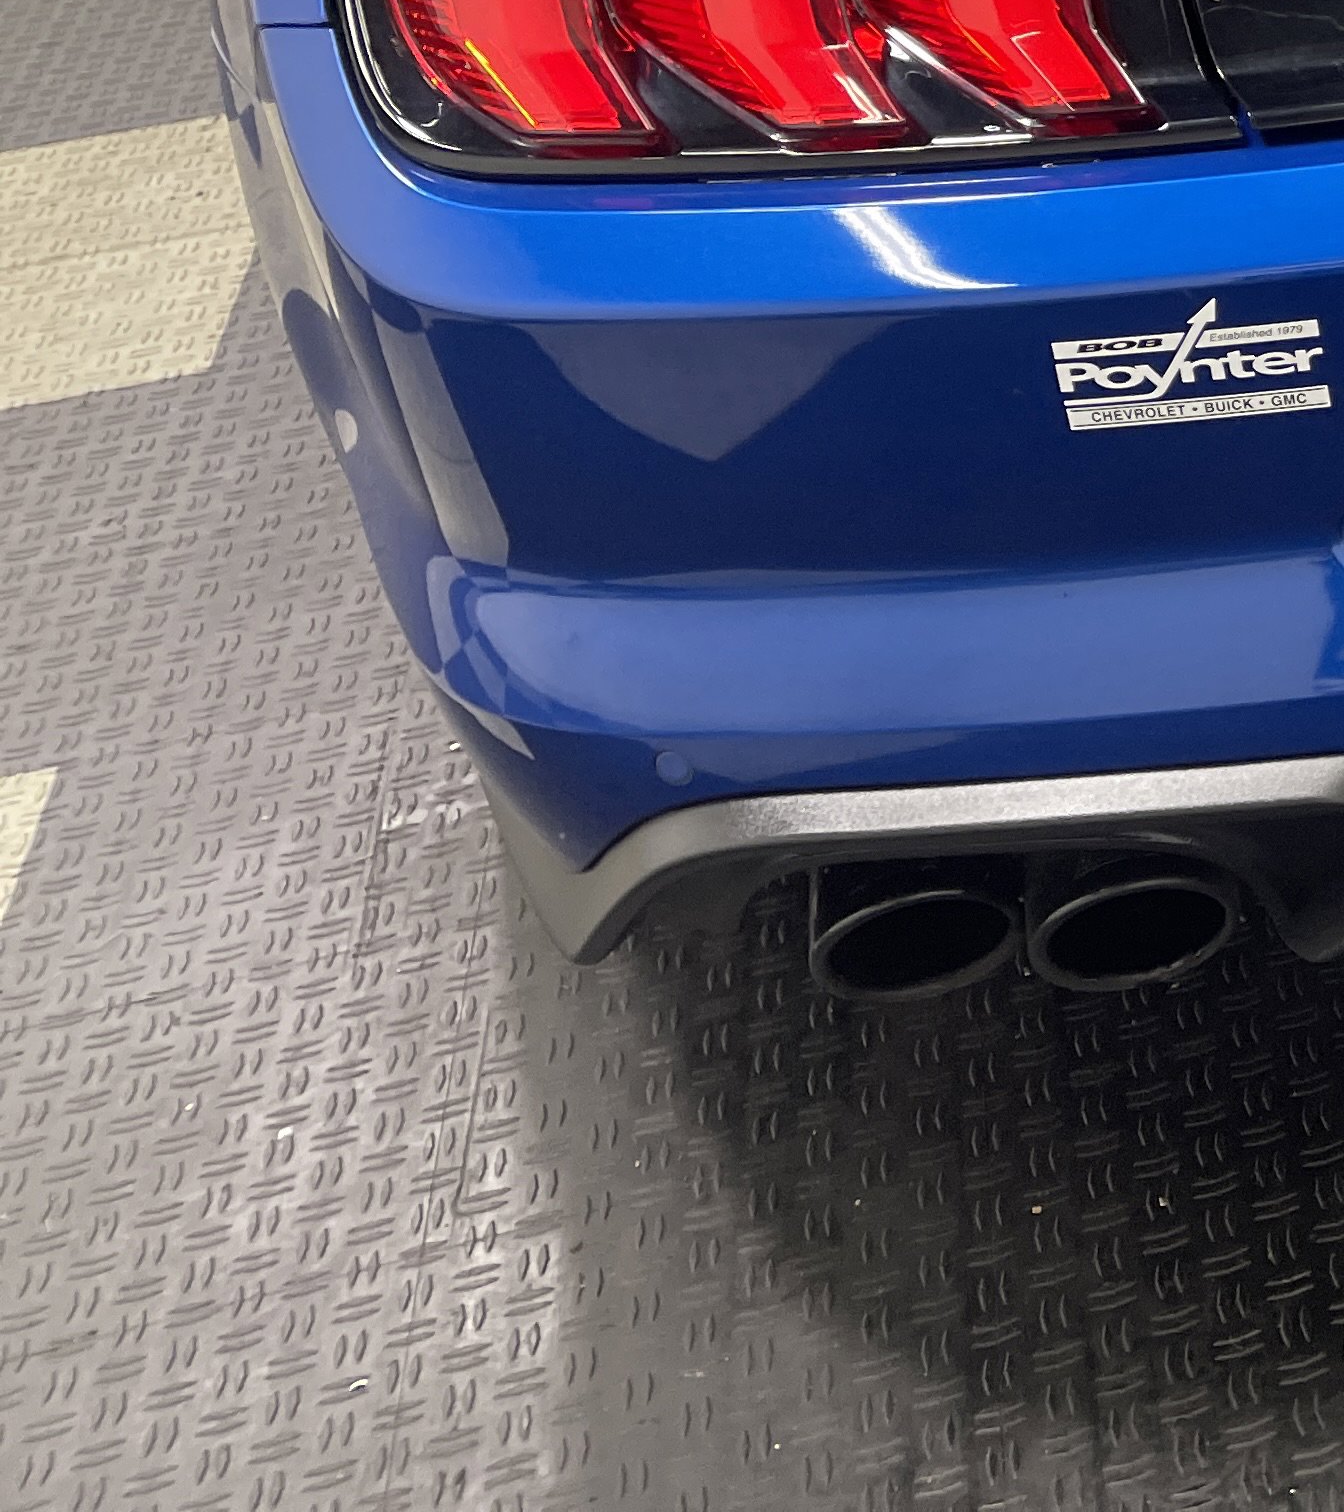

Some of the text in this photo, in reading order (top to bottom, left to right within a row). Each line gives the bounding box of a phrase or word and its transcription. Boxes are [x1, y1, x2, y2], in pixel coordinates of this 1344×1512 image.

[1076, 337, 1163, 354] BOB
[1209, 324, 1304, 343] Established 1979
[1055, 346, 1324, 399] Poynter
[1091, 392, 1308, 423] CHEVROLET BUICK GMC
